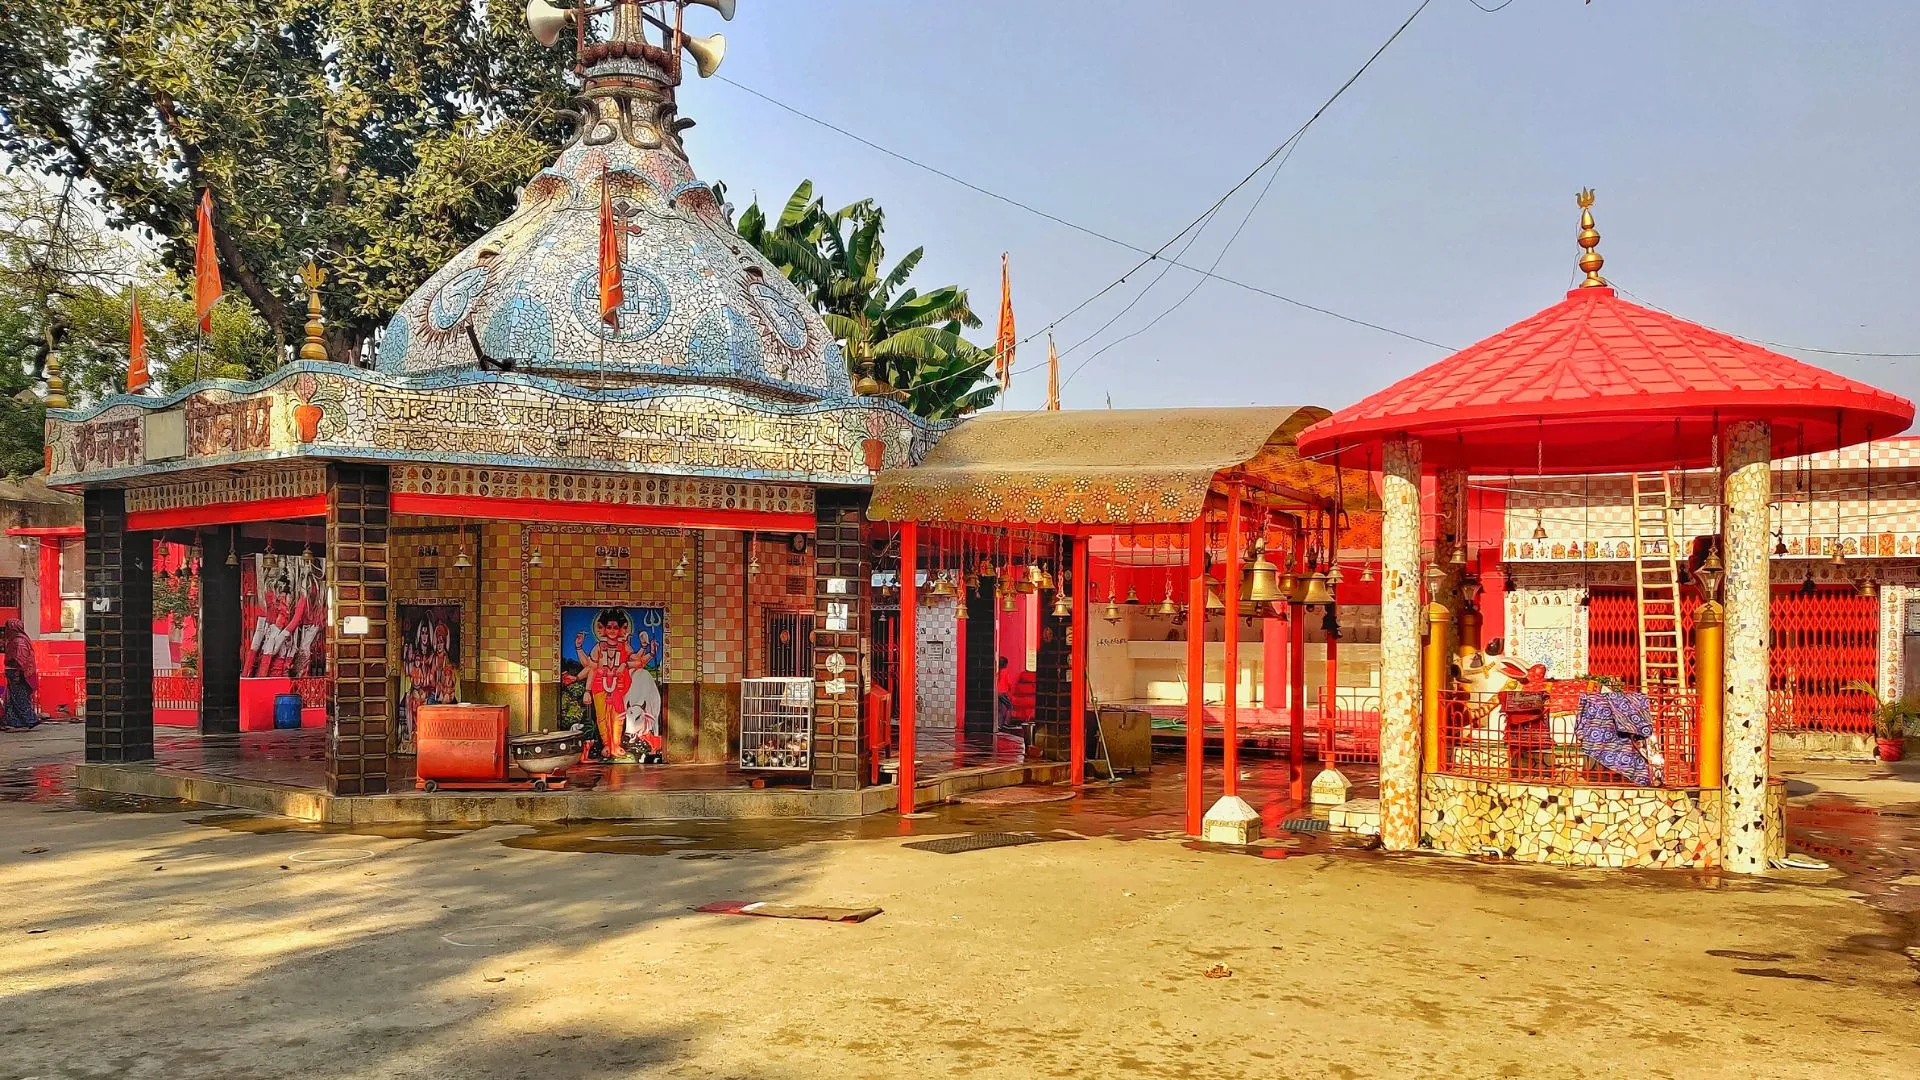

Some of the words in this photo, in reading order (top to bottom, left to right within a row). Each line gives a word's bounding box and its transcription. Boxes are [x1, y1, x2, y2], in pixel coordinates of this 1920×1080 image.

[96, 416, 141, 468] नमः
[184, 394, 274, 458] शिवाय
[502, 399, 552, 428] जब
[759, 415, 818, 446] काम
[817, 411, 843, 447] से
